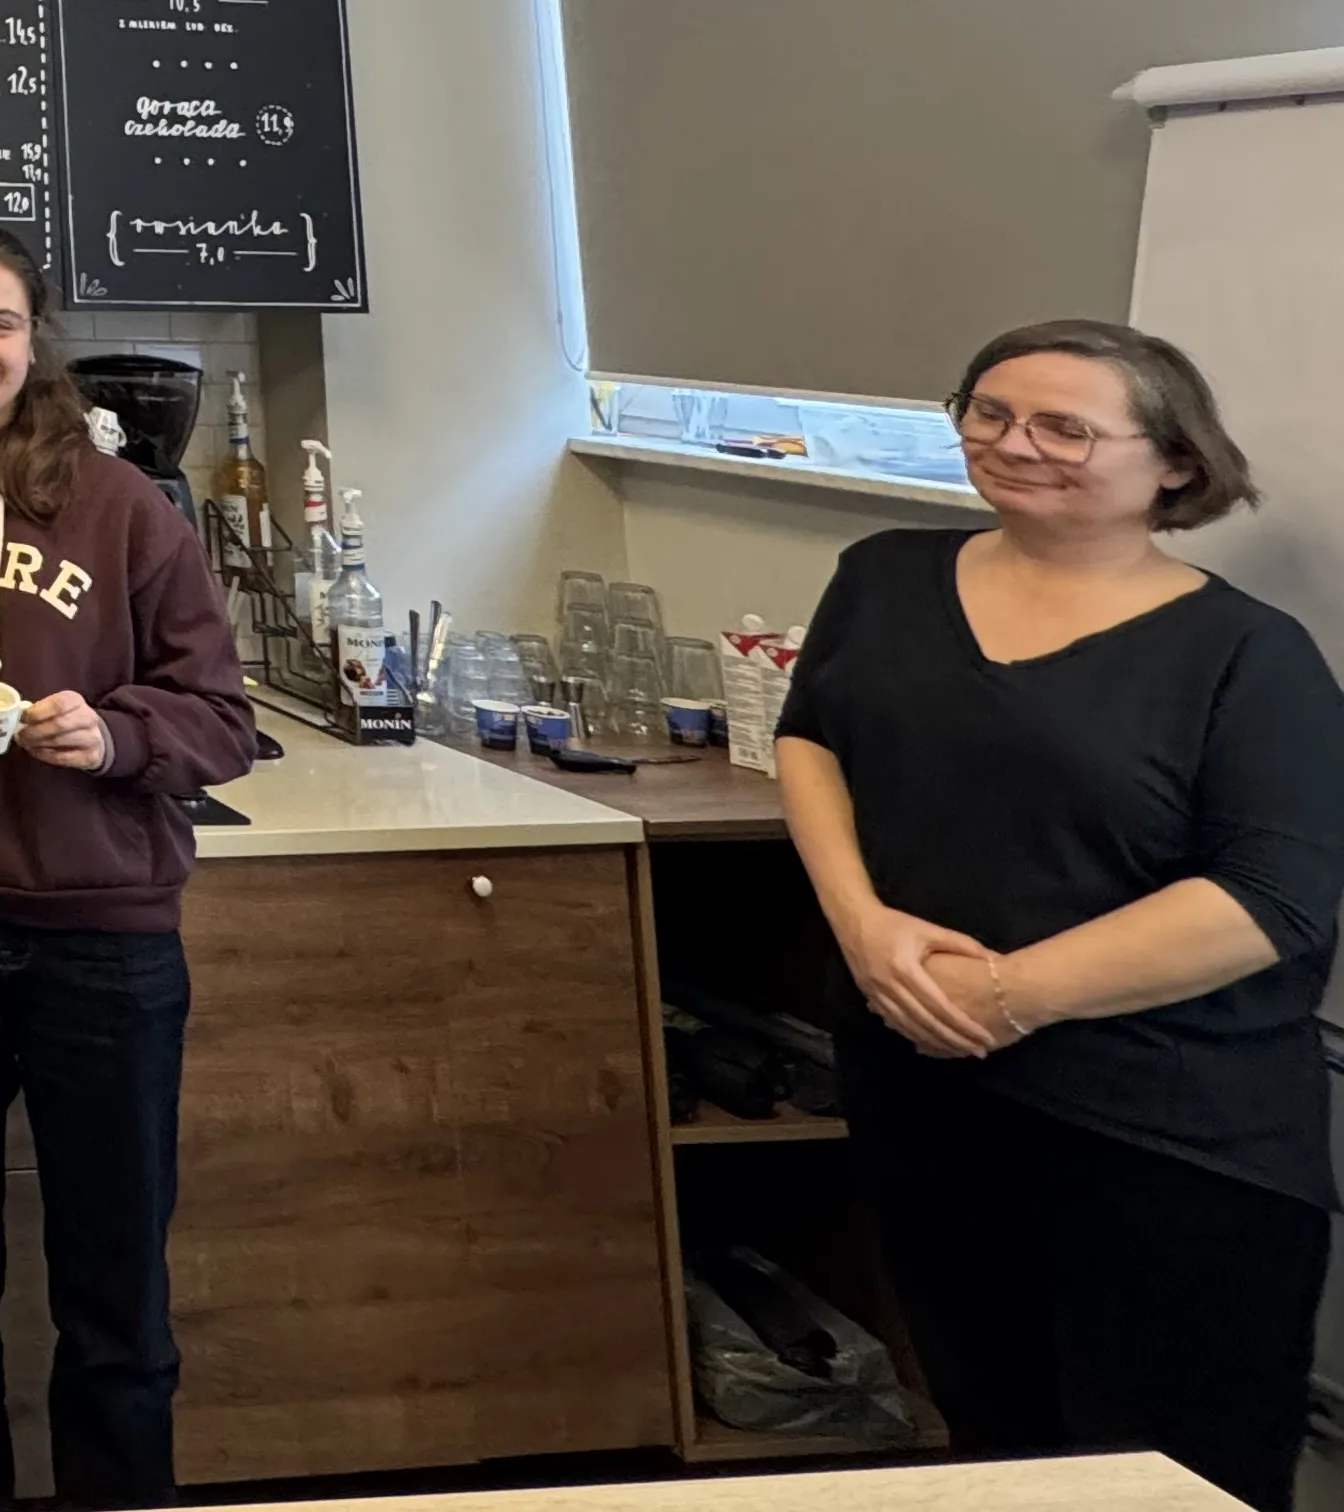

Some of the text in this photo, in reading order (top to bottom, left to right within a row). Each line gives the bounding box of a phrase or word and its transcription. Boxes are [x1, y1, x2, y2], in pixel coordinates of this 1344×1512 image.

[136, 96, 222, 120] gorąca
[124, 118, 246, 139] czekolada
[360, 712, 411, 729] MONIN
